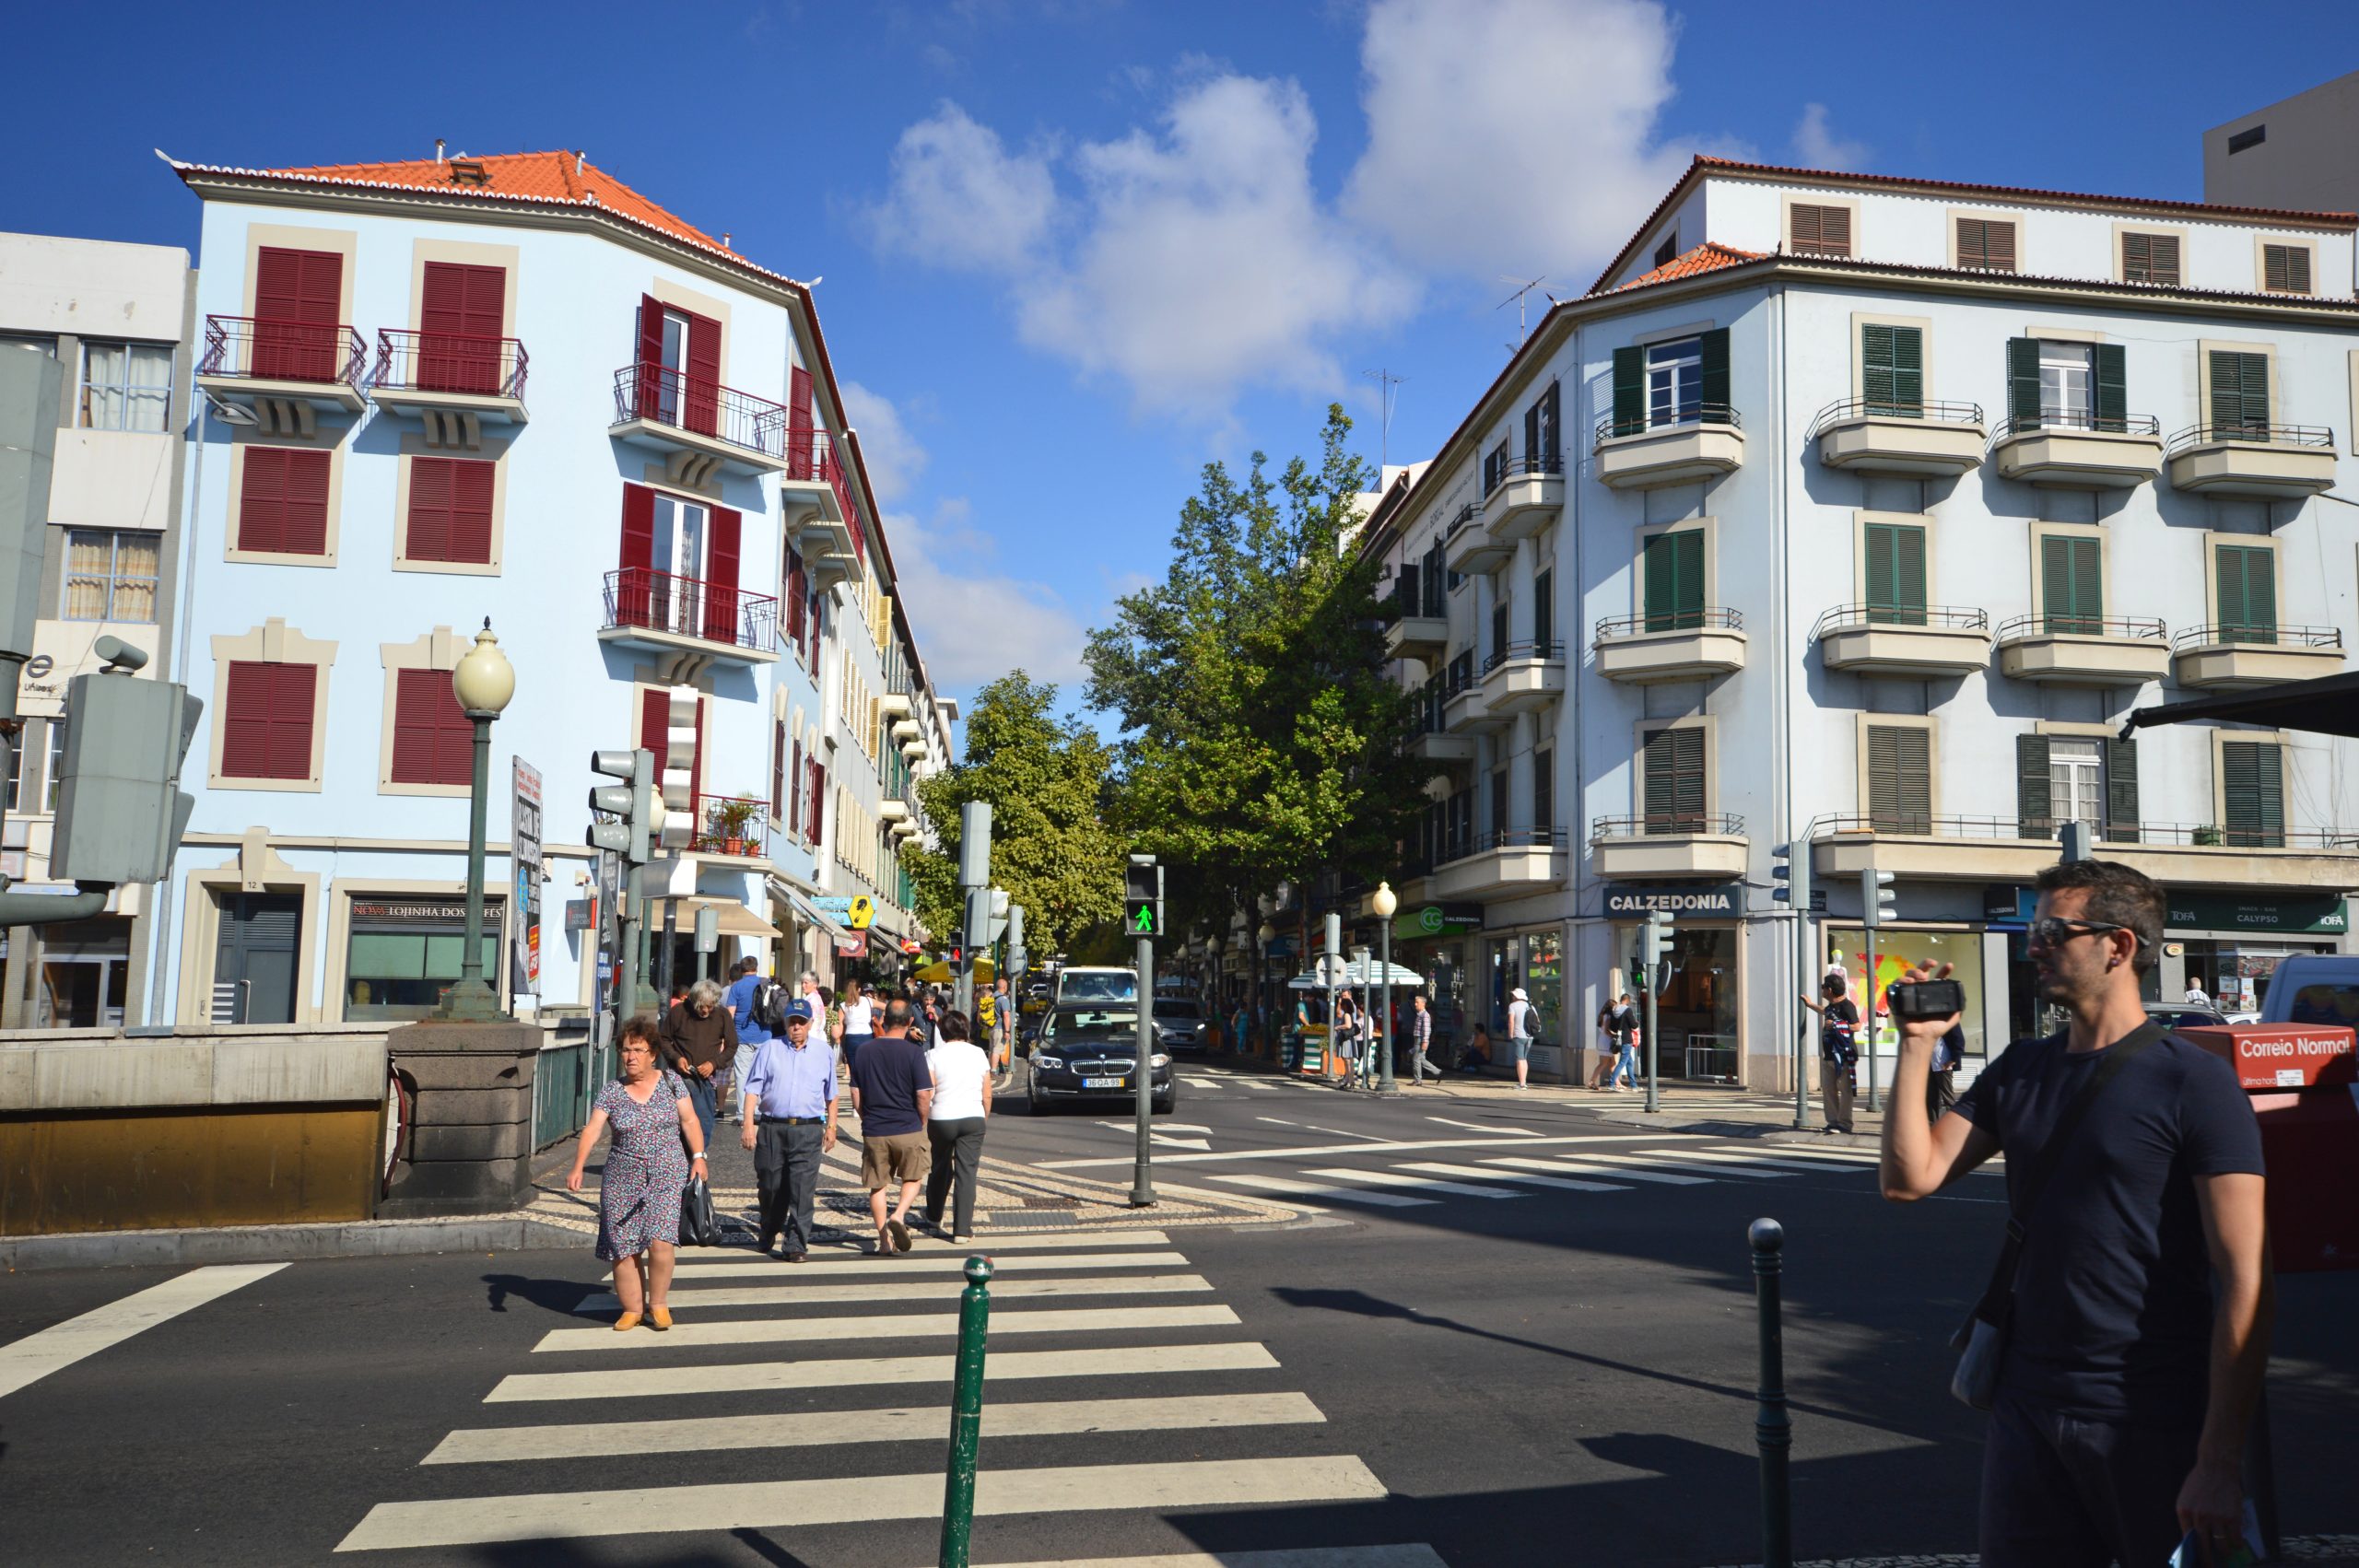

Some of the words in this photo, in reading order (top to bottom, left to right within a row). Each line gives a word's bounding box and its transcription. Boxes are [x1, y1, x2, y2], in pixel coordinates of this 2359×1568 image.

[1610, 895, 1731, 910] CALZEDONIA
[353, 906, 385, 915] NOVA
[389, 907, 439, 917] LOJINHA
[441, 907, 466, 917] DOS
[2171, 911, 2195, 921] TOFA
[2236, 915, 2278, 923] CALYPSO
[2318, 915, 2344, 926] TOFA
[2240, 1038, 2294, 1058] Correio
[2296, 1036, 2351, 1056] Normal
